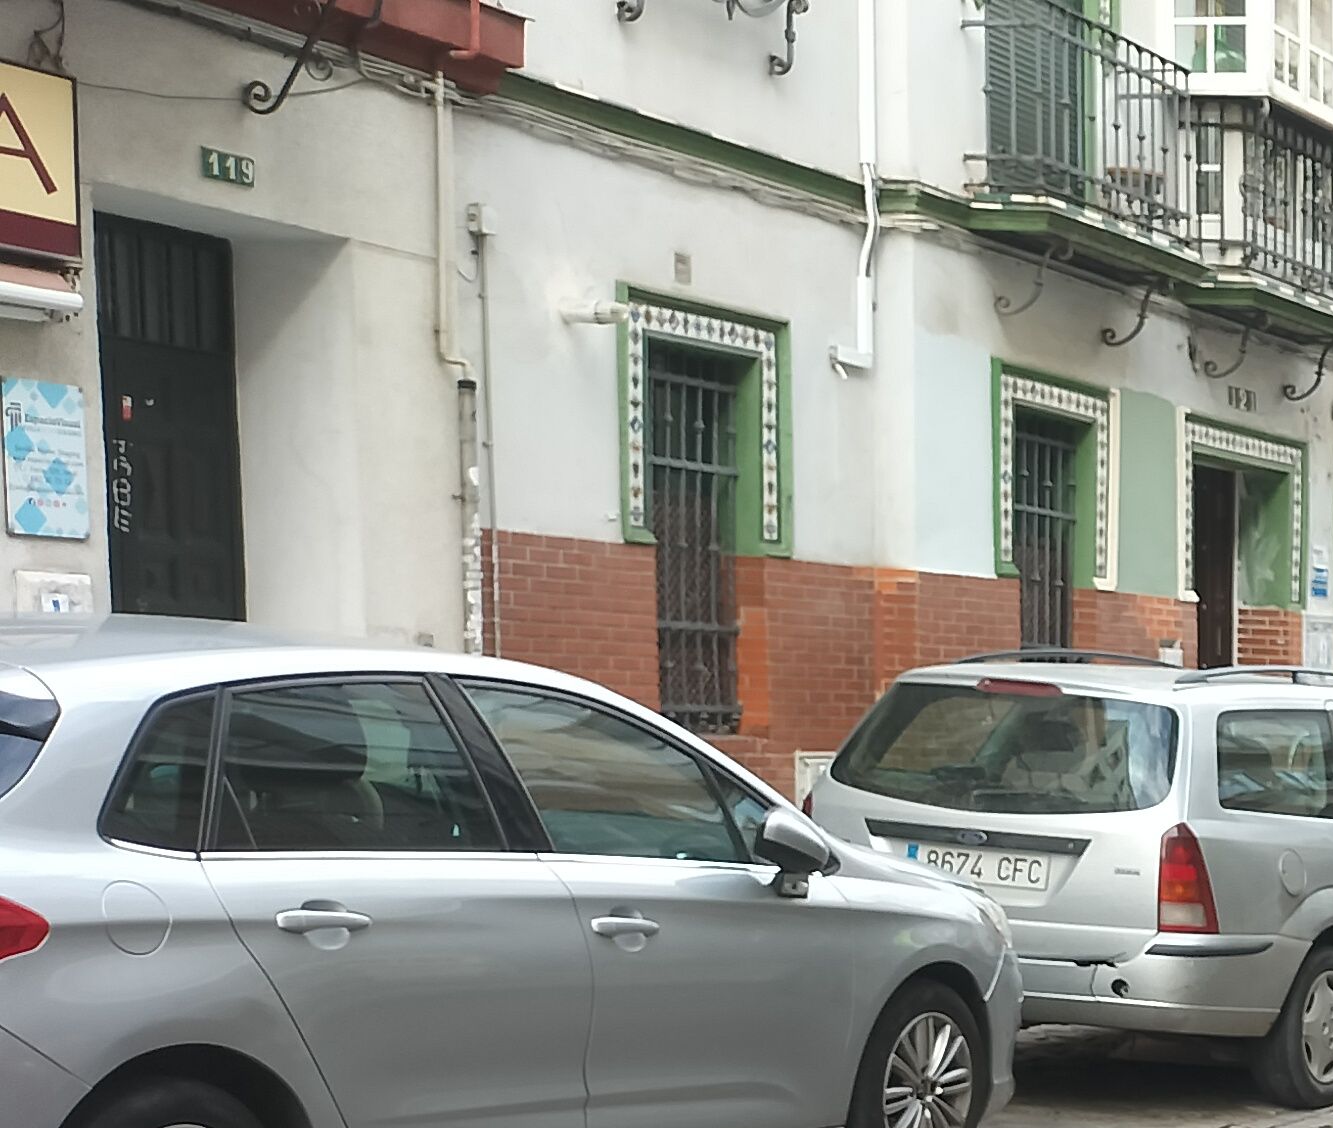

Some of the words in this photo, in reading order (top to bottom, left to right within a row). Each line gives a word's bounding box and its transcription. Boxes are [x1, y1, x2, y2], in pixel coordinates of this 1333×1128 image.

[0, 93, 58, 195] A
[209, 151, 254, 184] 119
[1229, 386, 1257, 411] 121
[926, 849, 983, 879] 8674
[997, 856, 1043, 884] CFC
